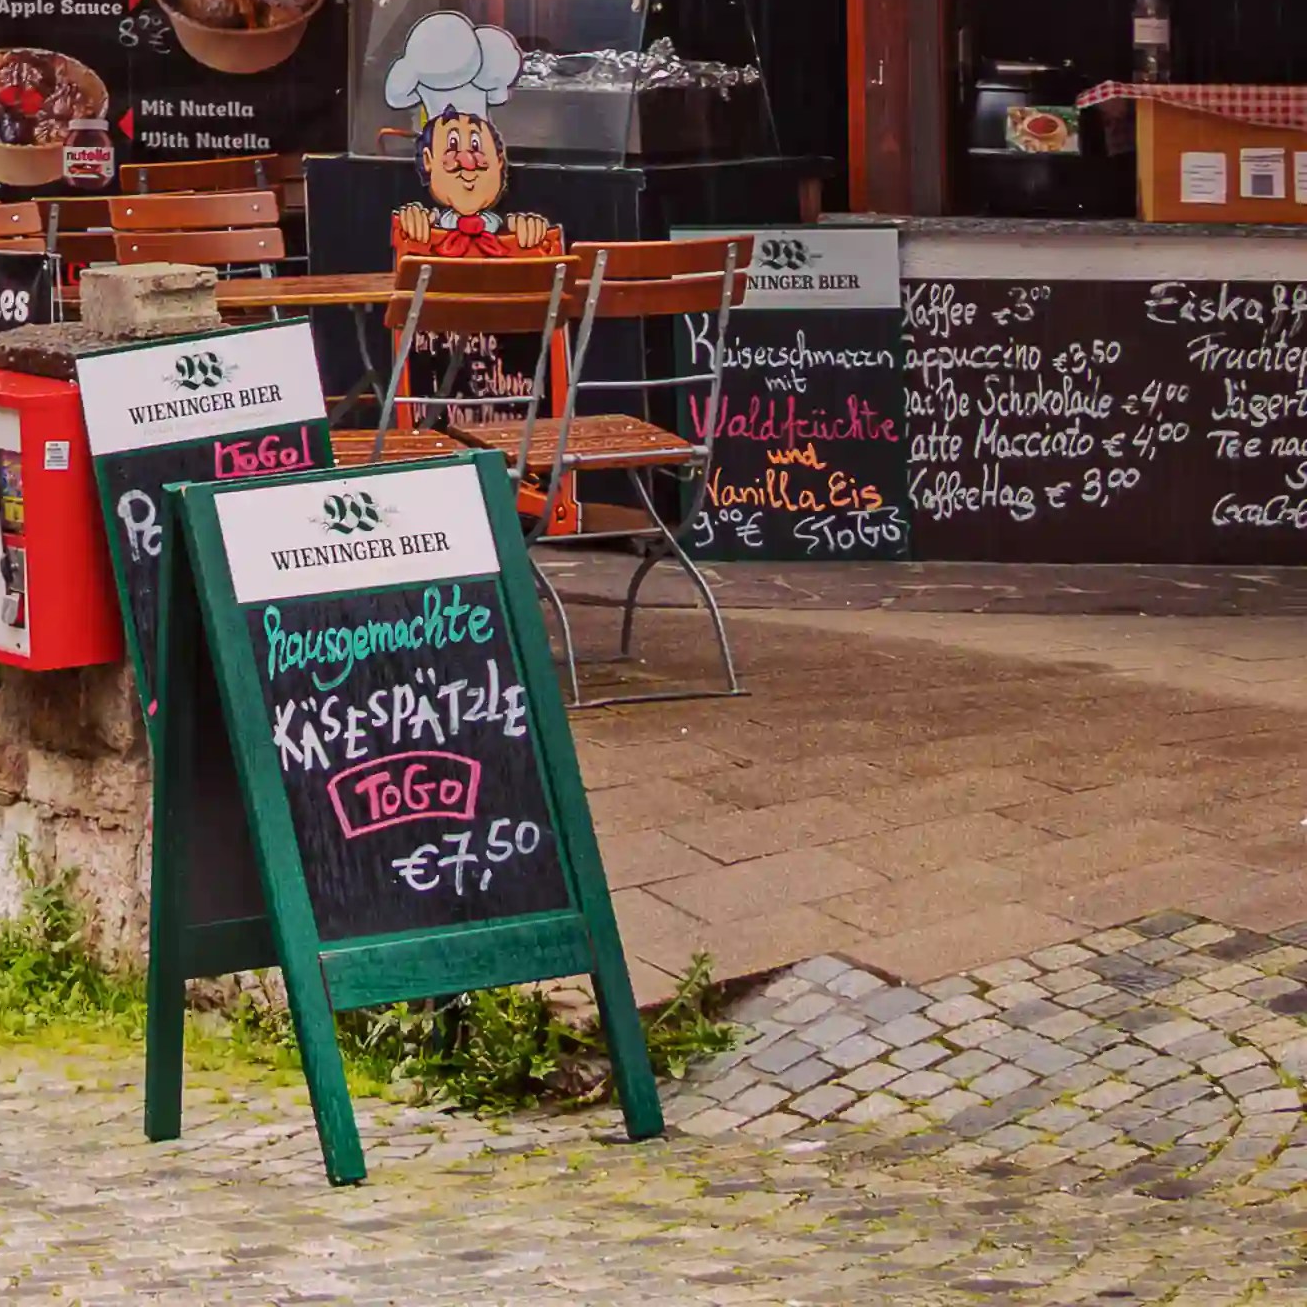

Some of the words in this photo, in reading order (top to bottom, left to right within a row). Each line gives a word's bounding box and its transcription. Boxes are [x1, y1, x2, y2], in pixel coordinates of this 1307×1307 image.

[141, 99, 175, 117] Mit
[180, 99, 254, 118] Nutella
[66, 149, 111, 162] nutella
[141, 132, 190, 149] With
[195, 132, 271, 150] Nutella
[747, 274, 817, 290] NINGER
[818, 273, 861, 289] BIER
[901, 283, 977, 337] Kaffee
[765, 369, 807, 393] mit
[129, 392, 235, 425] WIENINGER
[239, 384, 283, 409] BIER
[974, 419, 1094, 460] Macciato
[1207, 430, 1262, 459] Tee
[767, 442, 827, 470] und
[706, 466, 827, 512] Vanilla
[828, 470, 884, 512] Eis
[271, 538, 396, 571] WIENINGER
[401, 531, 451, 555] BIER
[391, 818, 540, 895] €7,50
